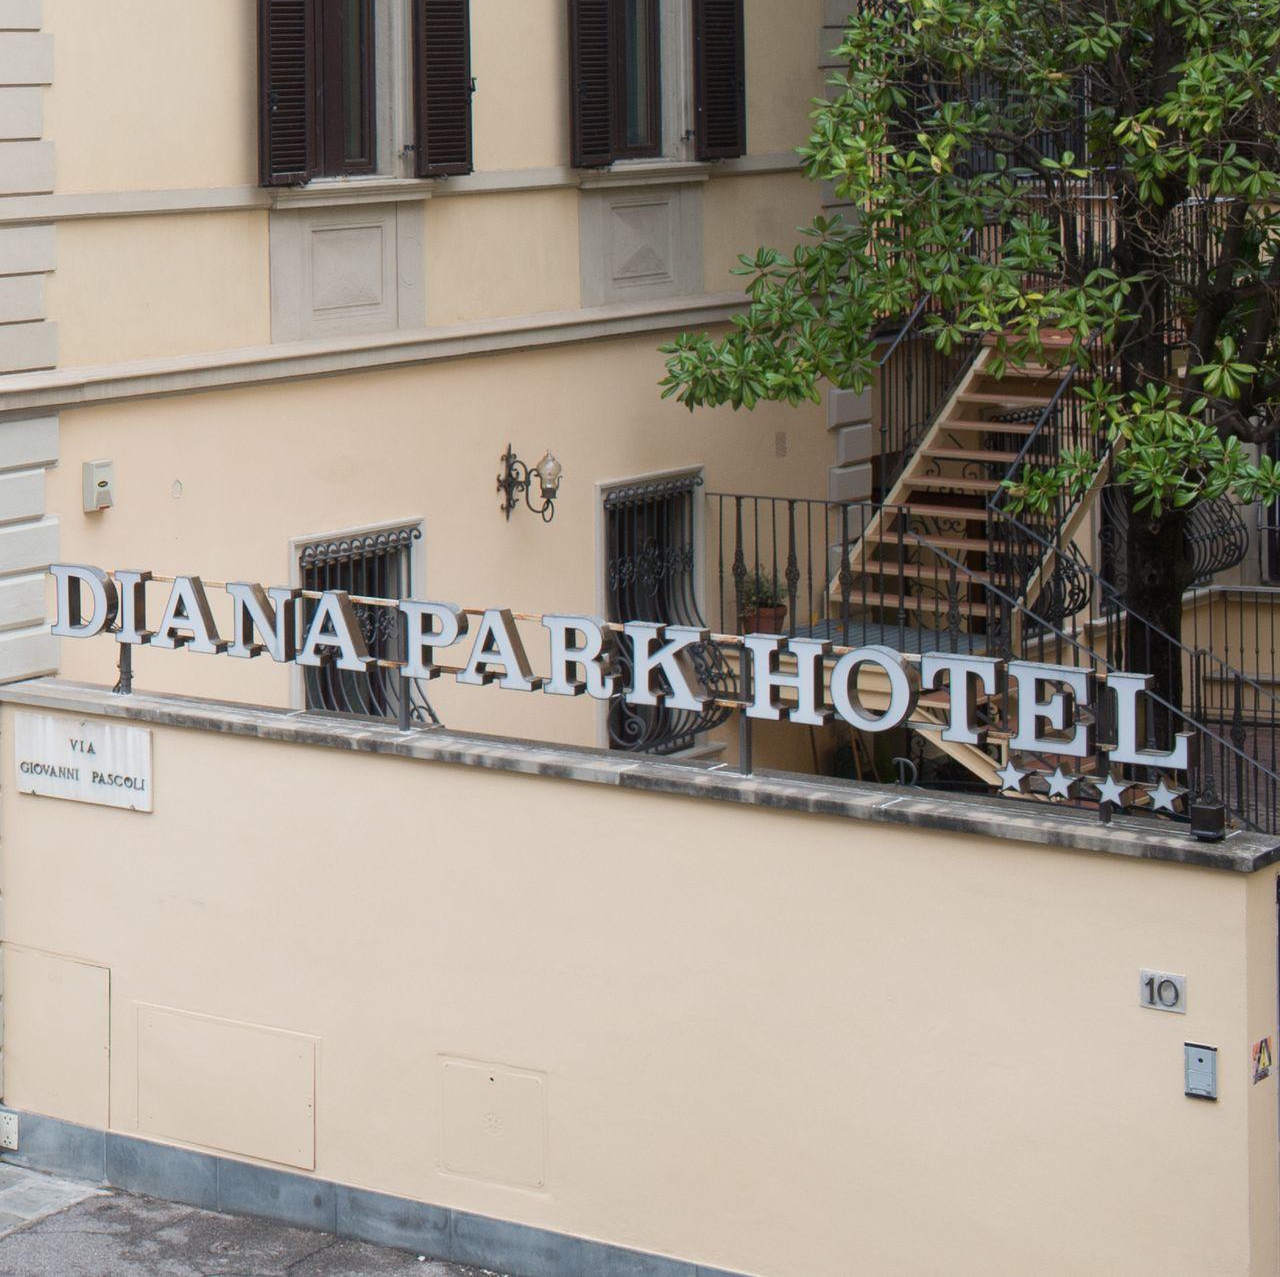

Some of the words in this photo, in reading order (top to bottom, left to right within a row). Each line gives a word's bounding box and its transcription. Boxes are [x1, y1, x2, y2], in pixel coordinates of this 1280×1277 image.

[49, 563, 378, 673] DIANA
[399, 599, 711, 712] PARK
[743, 632, 1197, 770] HOTEL
[69, 738, 96, 755] VIA
[19, 761, 80, 781] GIOVANNI
[92, 771, 145, 791] PASCOLI
[1144, 976, 1180, 1008] 10
